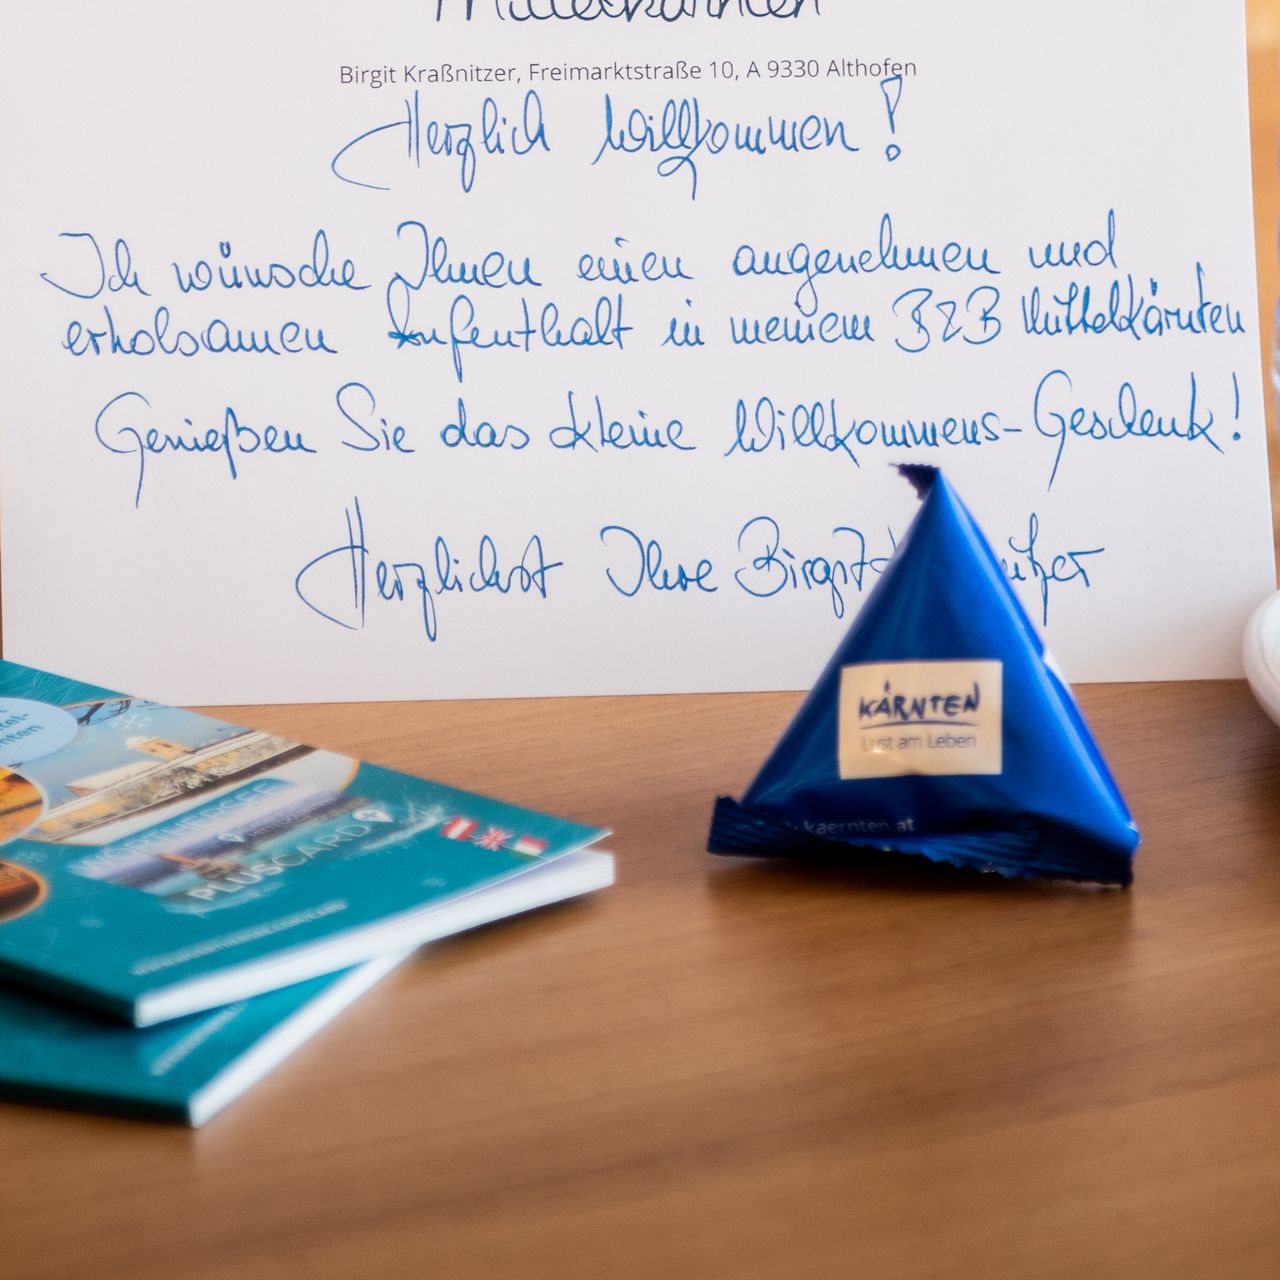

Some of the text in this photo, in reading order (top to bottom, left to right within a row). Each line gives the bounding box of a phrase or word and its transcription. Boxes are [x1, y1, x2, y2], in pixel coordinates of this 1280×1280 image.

[339, 58, 917, 89] Birgit Kraßnitzer, Freimarktstraße 10, A 9330 Althofen
[330, 89, 551, 194] Herzlich
[40, 208, 1118, 319] Ich wünsche Ihnen einen angenehmen und
[62, 305, 339, 358] erholsamen
[660, 297, 706, 348] in
[729, 310, 876, 347] meinem
[94, 390, 318, 508] Genießen
[335, 381, 417, 454] Sie
[440, 397, 532, 452] das
[548, 389, 698, 453] kleine
[598, 524, 718, 599] Ihre
[733, 515, 869, 621] Birgit
[858, 680, 981, 721] KÄRNTEN
[897, 737, 923, 750] am
[927, 732, 978, 750] Leben
[186, 823, 371, 902] PLUSCARD
